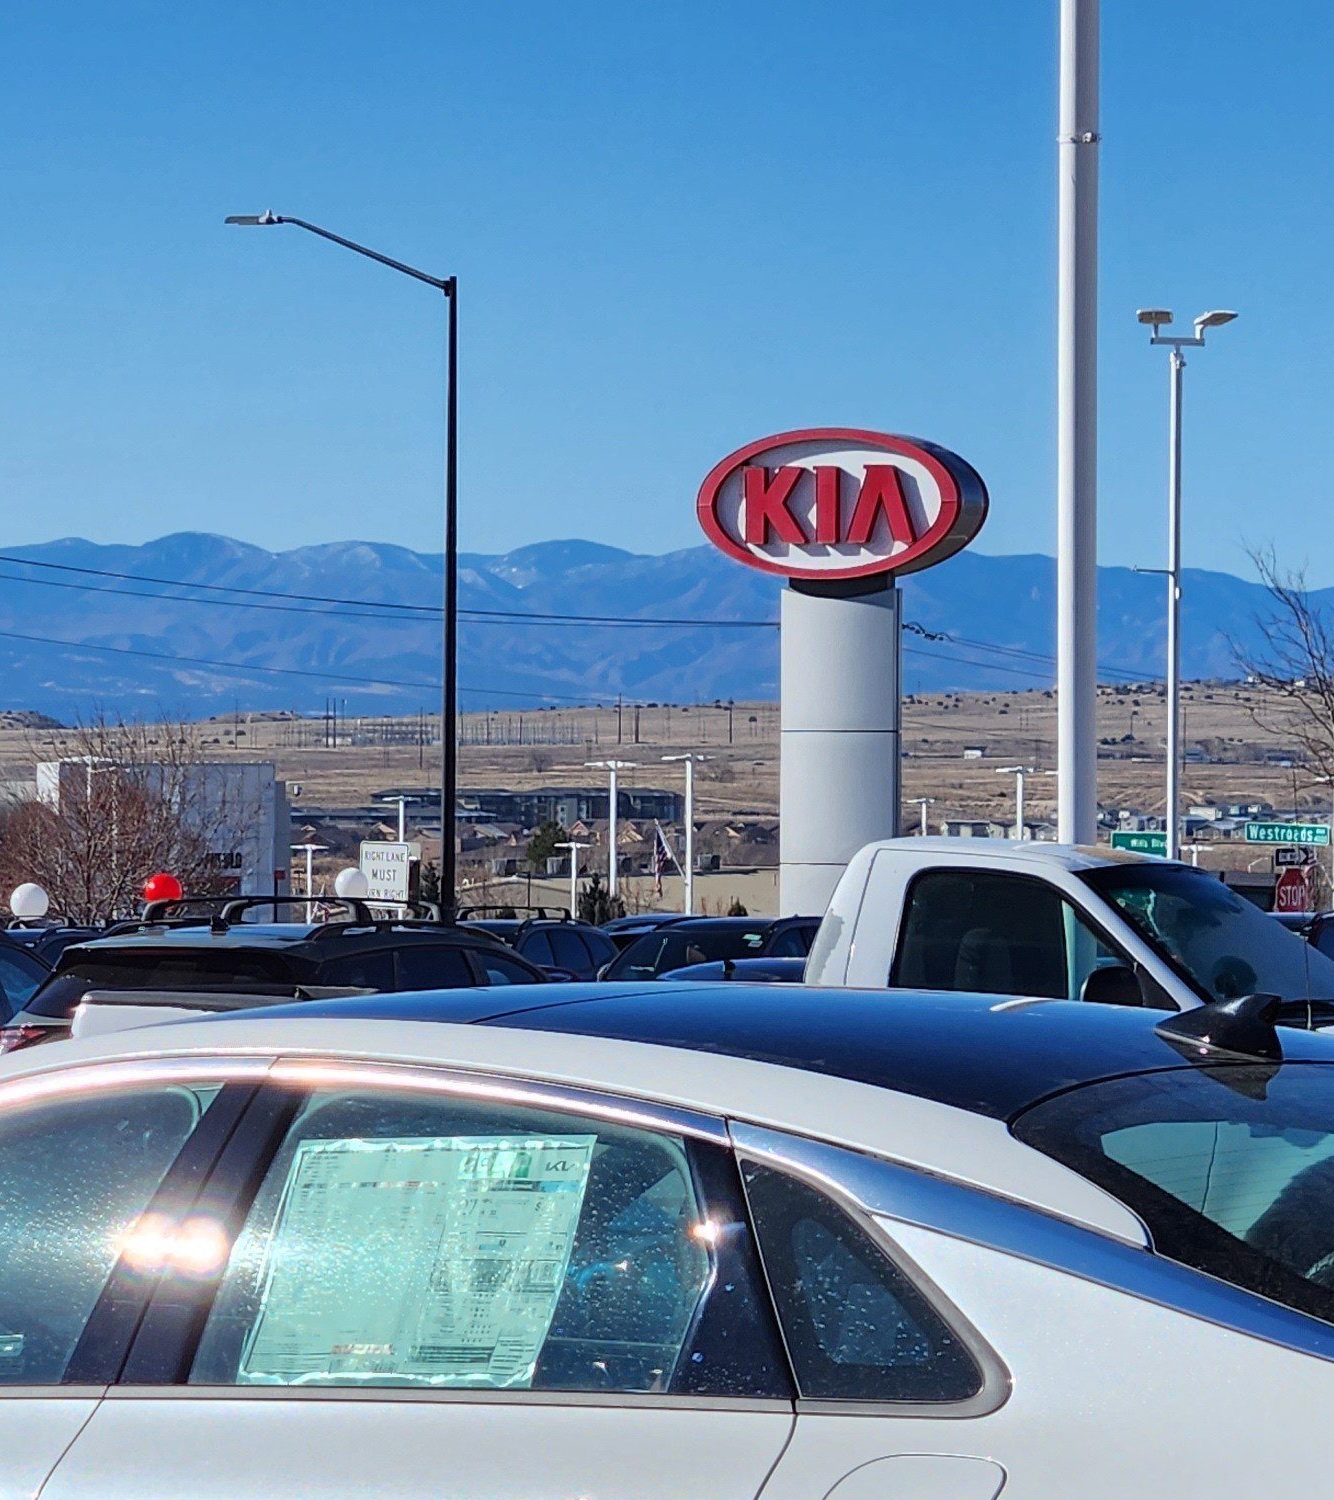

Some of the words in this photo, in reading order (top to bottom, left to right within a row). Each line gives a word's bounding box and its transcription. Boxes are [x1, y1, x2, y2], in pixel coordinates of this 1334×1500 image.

[743, 464, 917, 545] KIA
[371, 868, 397, 881] MUST
[1278, 885, 1305, 907] STOP
